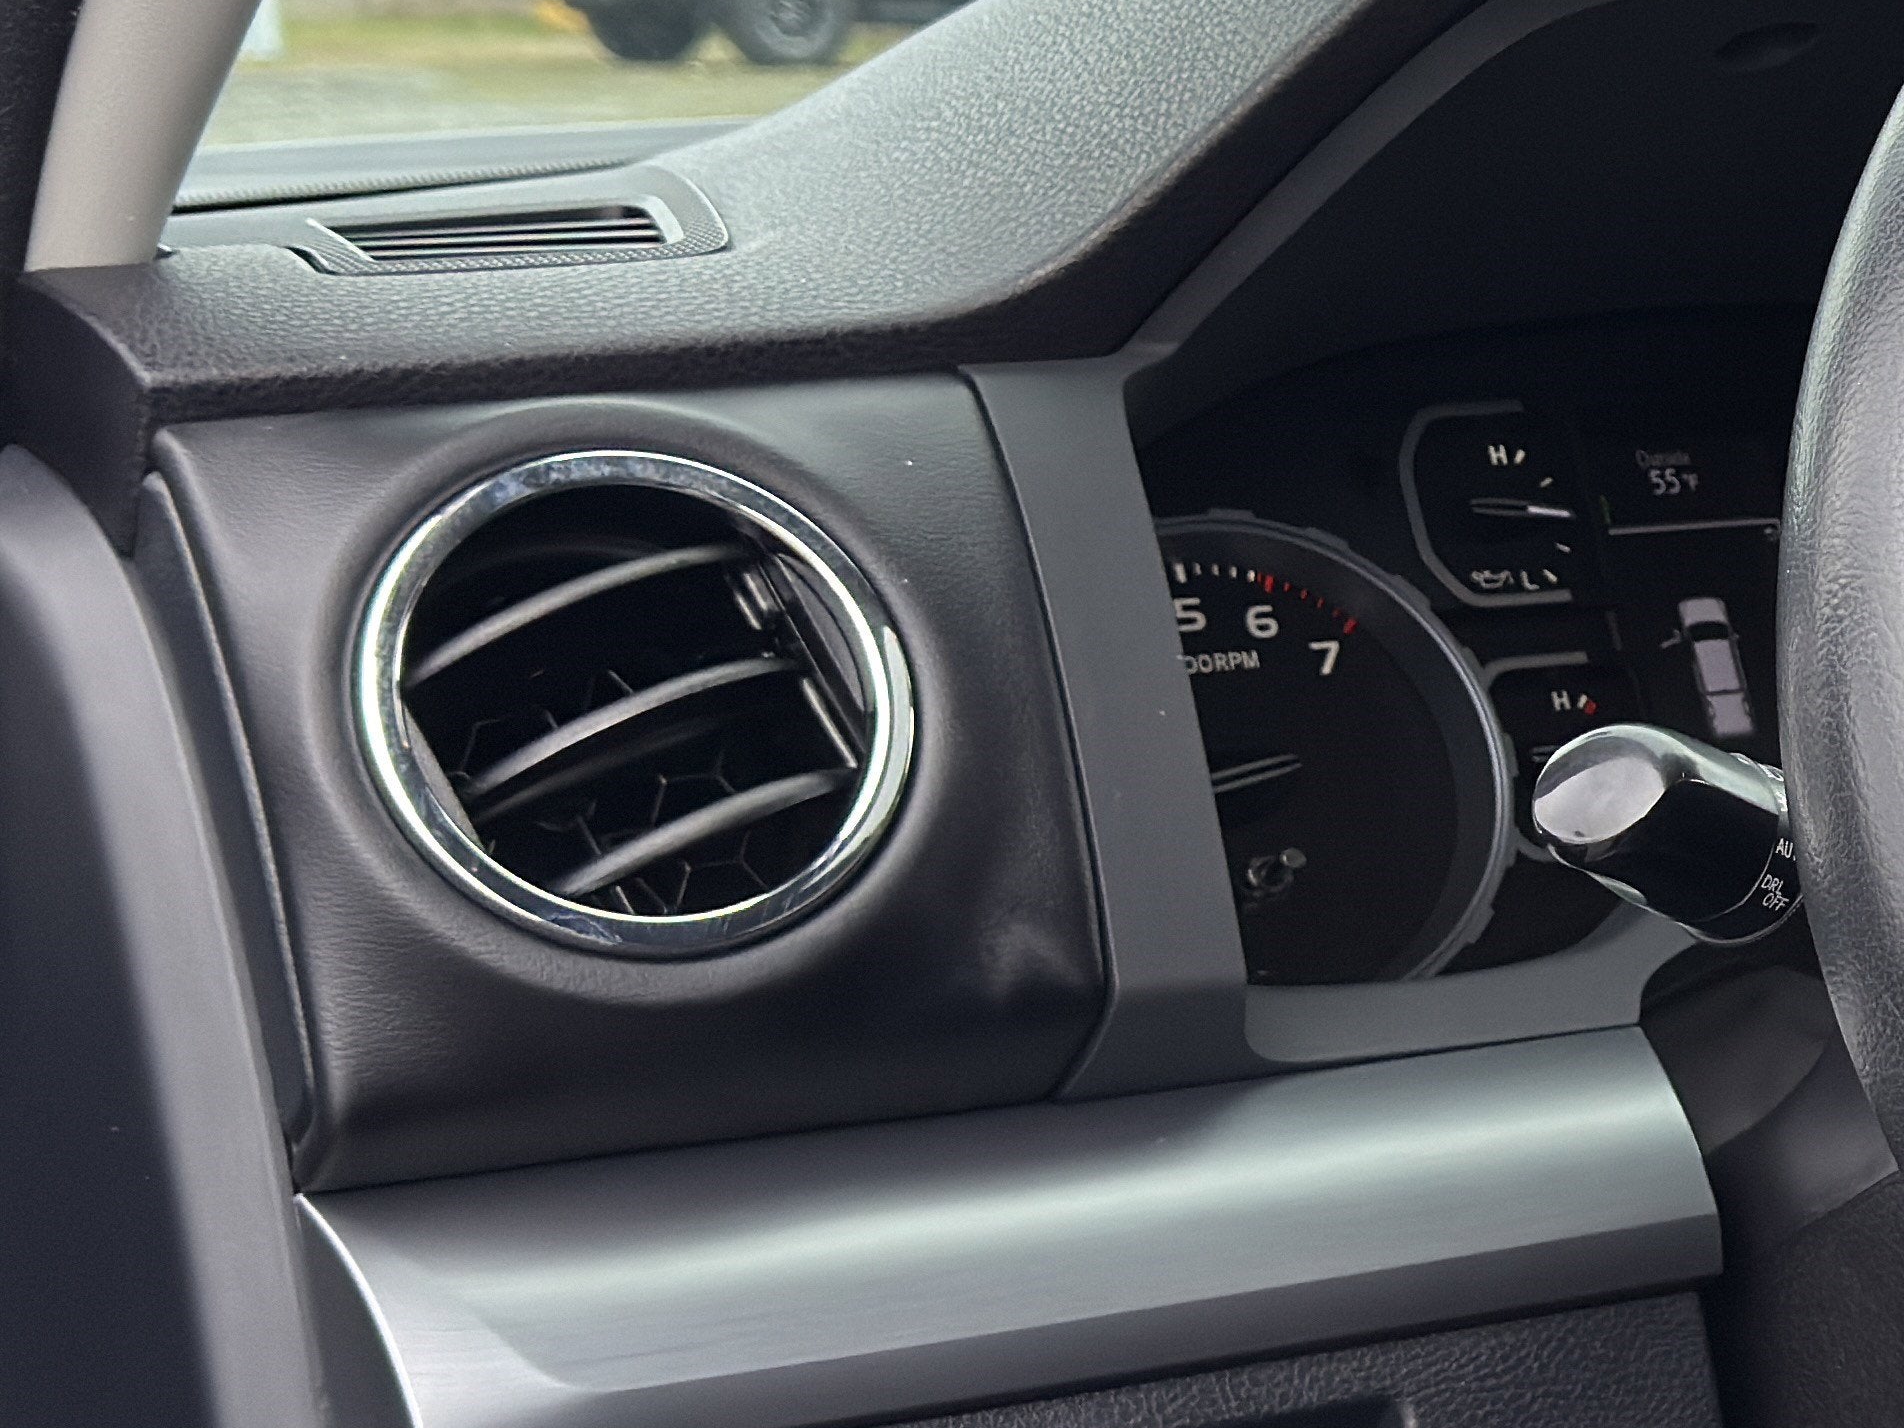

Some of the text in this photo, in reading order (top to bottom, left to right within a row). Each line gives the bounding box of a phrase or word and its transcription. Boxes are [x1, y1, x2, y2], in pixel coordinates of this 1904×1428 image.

[1173, 598, 1207, 633] 5
[1246, 605, 1279, 639] 6
[1309, 640, 1340, 676] 7
[1760, 873, 1784, 897] DRL
[1762, 892, 1790, 912] OFF
